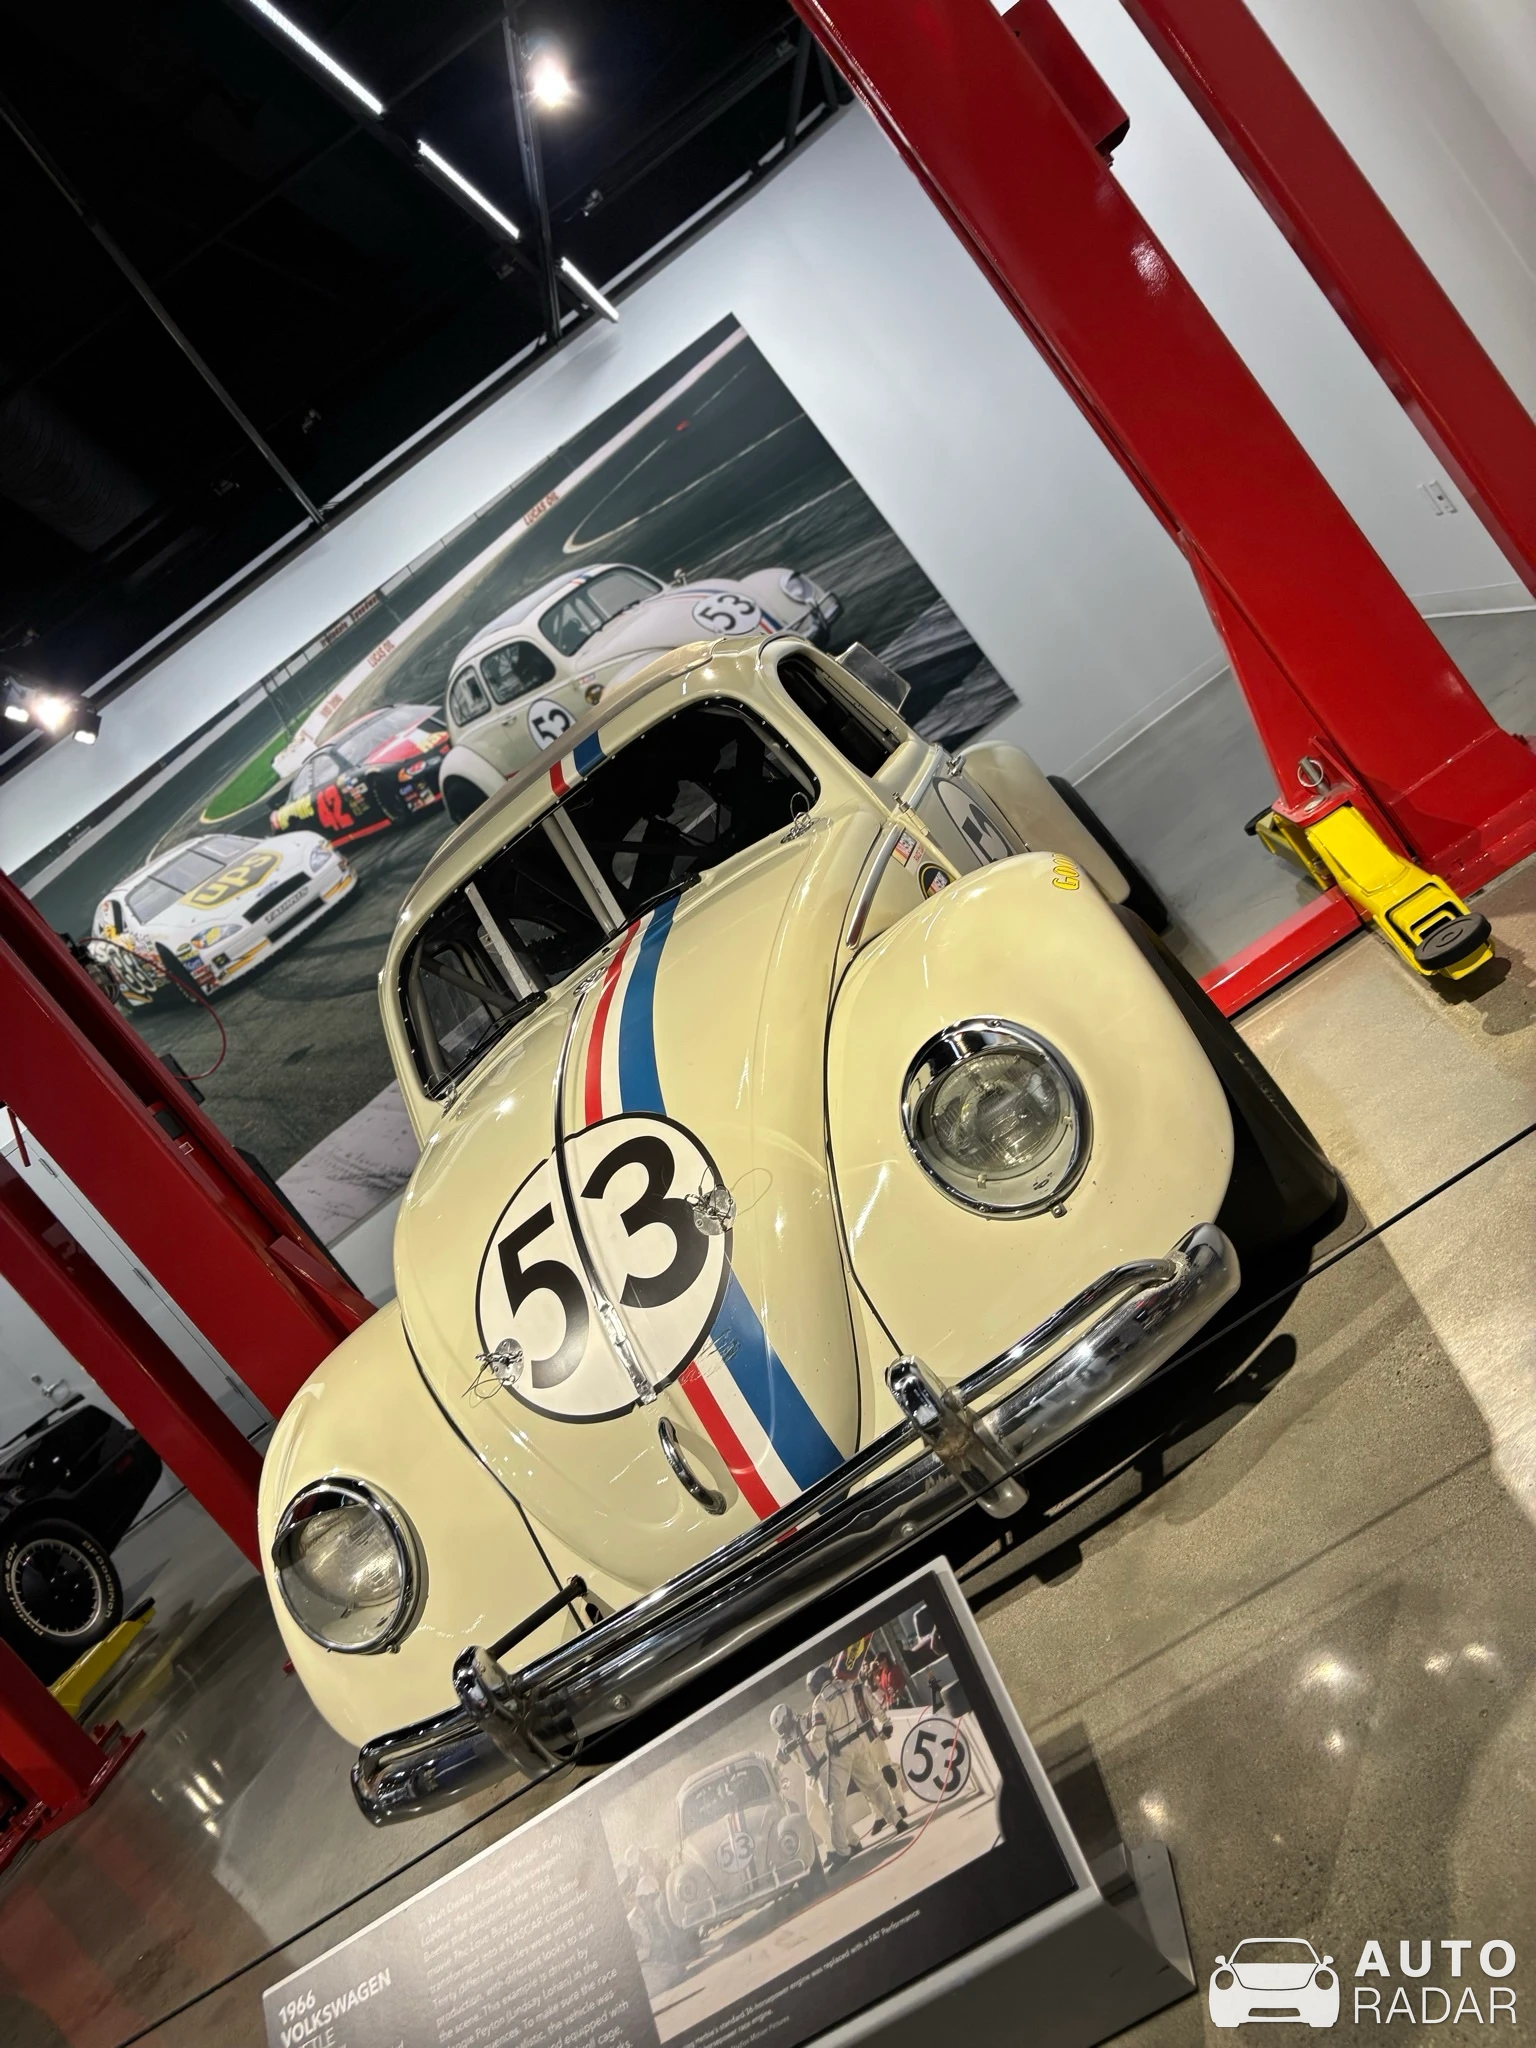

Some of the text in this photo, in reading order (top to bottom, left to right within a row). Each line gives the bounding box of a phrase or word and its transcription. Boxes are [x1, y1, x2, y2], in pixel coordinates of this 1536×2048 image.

[698, 594, 755, 631] 53
[531, 709, 571, 740] 53
[315, 785, 354, 831] 42
[497, 1135, 711, 1389] 53
[907, 1730, 967, 1793] 53
[542, 1833, 563, 1851] Fully
[720, 1835, 754, 1868] 53
[530, 1874, 551, 1894] 1968
[452, 1946, 469, 1961] The
[468, 1934, 489, 1951] Love
[542, 1890, 558, 1905] this
[559, 1877, 579, 1894] time
[789, 1973, 812, 1991] engine
[811, 1966, 824, 1978] was
[823, 1948, 851, 1971] replaced
[850, 1941, 865, 1955] with
[868, 1929, 882, 1943] FAT
[881, 1908, 921, 1937] Performance
[428, 1955, 480, 1994] transformed
[498, 1942, 505, 1951] a
[504, 1916, 544, 1947] NASCAR
[432, 1912, 585, 2010] Thirty different vehicles were used in
[503, 1953, 541, 1985] different
[541, 1941, 566, 1961] looks
[567, 1936, 577, 1946] to
[578, 1922, 595, 1939] suit
[278, 1988, 316, 2025] 1966
[280, 1967, 391, 2048] VOLKSWAGEN
[437, 2027, 454, 2043] the
[482, 2000, 500, 2016] This
[501, 1976, 538, 2005] example
[538, 1972, 547, 1982] is
[547, 1953, 576, 1977] driven
[575, 1945, 590, 1959] by
[474, 2015, 505, 2039] Peyton
[504, 1993, 542, 2024] (Lindsay
[541, 1972, 573, 2000] Lohan)
[582, 1959, 599, 1975] the
[521, 2017, 534, 2030] To
[535, 2003, 559, 2023] make
[559, 1990, 580, 2008] sure
[579, 1980, 596, 1995] the
[596, 1967, 617, 1986] race
[546, 2019, 563, 2035] the
[563, 1999, 596, 2025] vehicle
[596, 1988, 615, 2006] was
[562, 2009, 608, 2046] equipped
[608, 1997, 629, 2018] with
[597, 2025, 624, 2045] cage,
